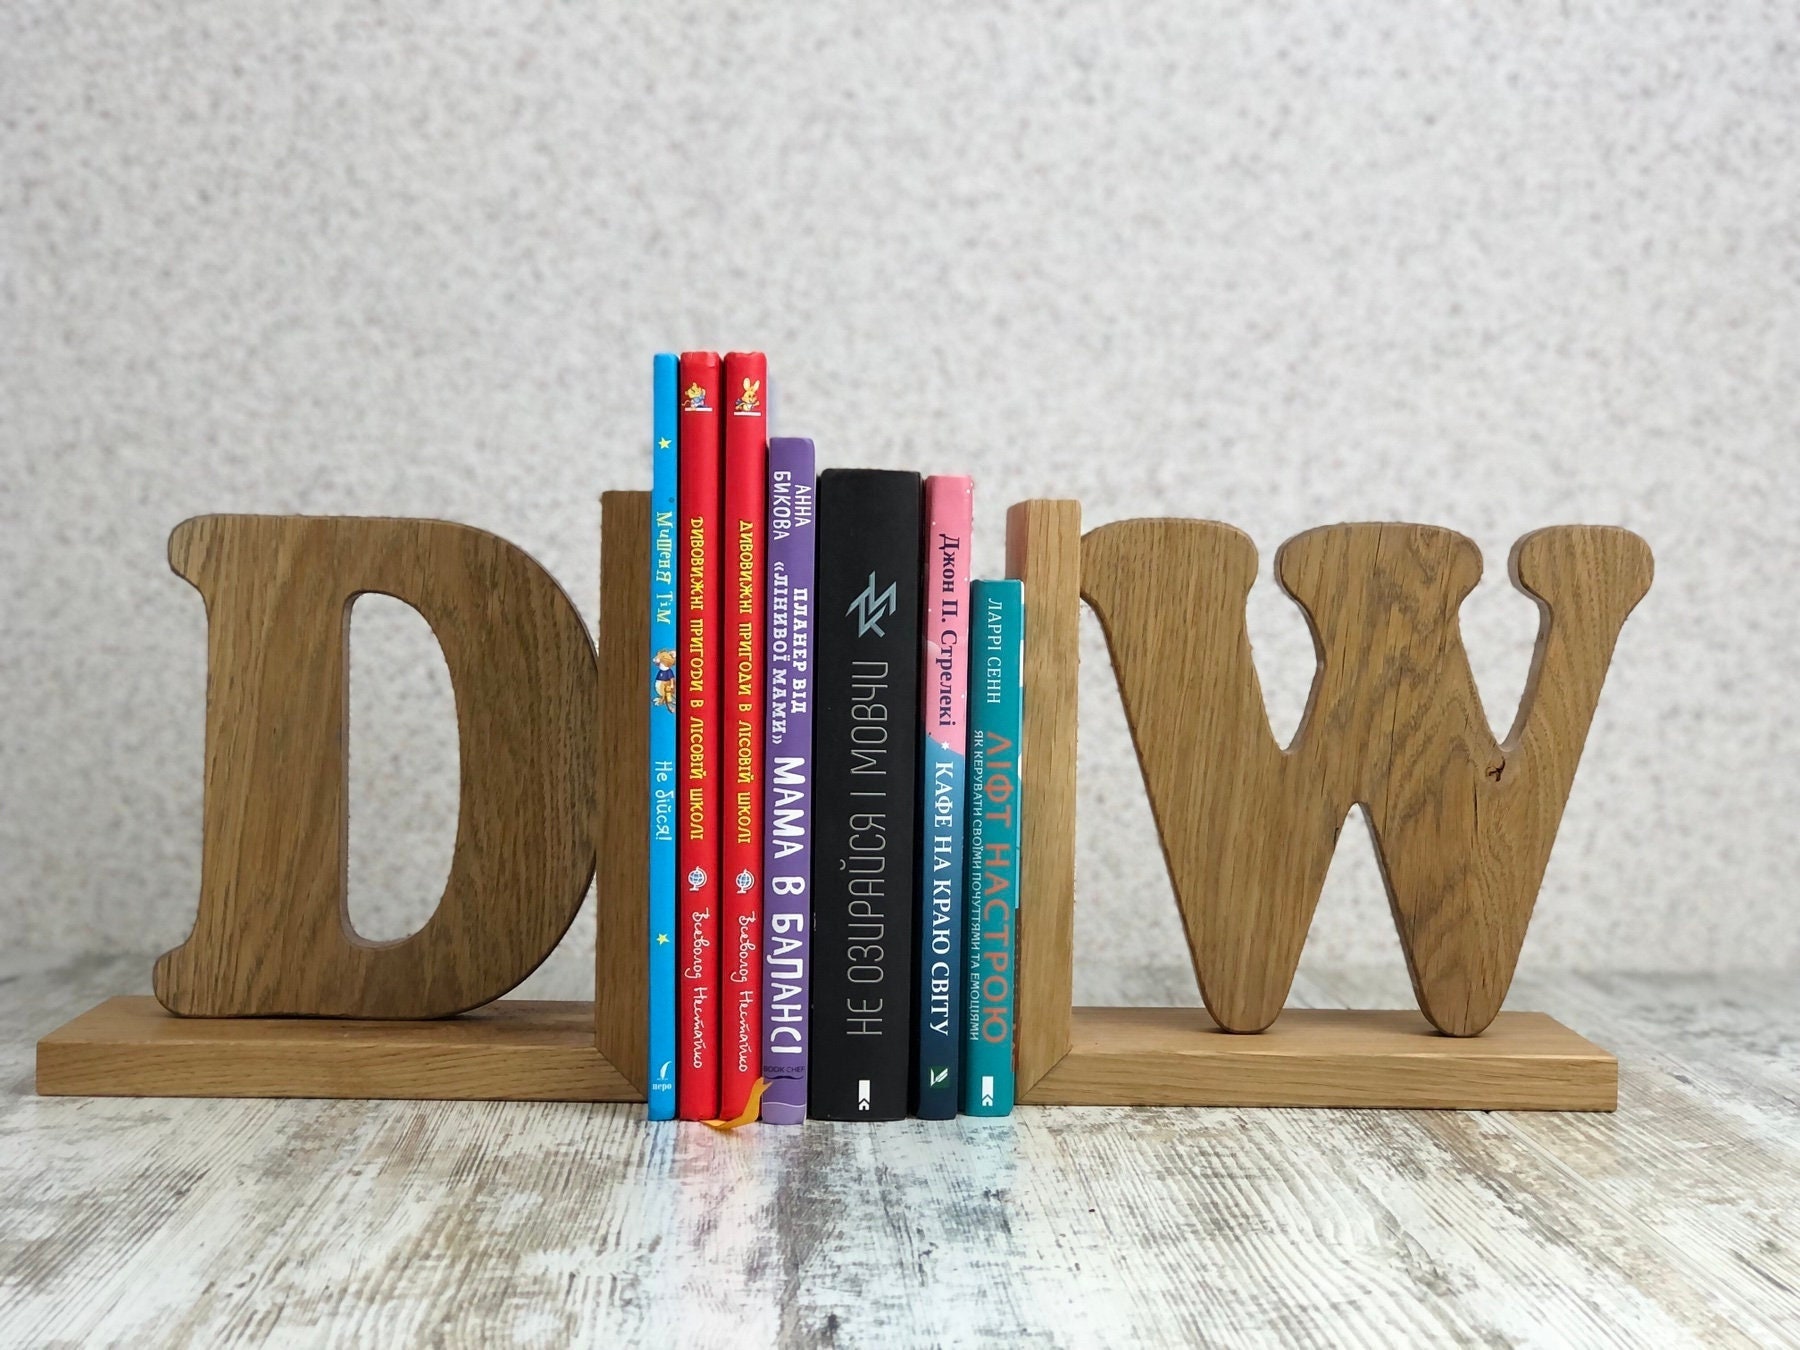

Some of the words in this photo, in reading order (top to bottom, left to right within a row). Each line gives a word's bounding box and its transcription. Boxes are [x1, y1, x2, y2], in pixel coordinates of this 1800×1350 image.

[773, 471, 791, 541] БИКОВА
[795, 484, 811, 527] АННА
[690, 517, 704, 610] ДИВОВИЖНІ
[738, 520, 752, 614] ДИВОВИЖНІ
[939, 533, 960, 595] Джон
[770, 561, 790, 664] «ЛІНИВОЇ
[792, 588, 807, 671] ПЛАНЕР
[938, 599, 959, 623] П.
[987, 598, 1002, 650] ЛАРРІ
[690, 619, 704, 692] ПРИГОДИ
[738, 622, 752, 696] ПРИГОДИ
[935, 629, 957, 727] Стрелекі
[986, 656, 1001, 704] СЕНН
[690, 700, 702, 708] В
[738, 704, 751, 712] В
[771, 668, 787, 745] МАМИ»
[790, 680, 806, 713] ВІД
[849, 660, 889, 775] МОВЧИ
[654, 761, 672, 783] Не
[688, 717, 706, 780] ЛІСОВІЙ
[736, 720, 754, 784] ЛІСОВІЙ
[973, 730, 984, 748] ЯК
[773, 757, 805, 860] МАМА
[934, 761, 954, 828] КАФЕ
[972, 751, 984, 816] КЕРУВАТИ
[984, 731, 1014, 828] ЛІФТ
[654, 790, 673, 841] бійся!
[690, 788, 704, 840] ШКОЛІ
[738, 792, 752, 844] ШКОЛІ
[972, 819, 984, 868] СВОЇМИ
[773, 876, 804, 895] В
[934, 836, 952, 872] НА
[840, 813, 886, 984] ОЗИРАЙСЯ
[933, 879, 952, 955] КРАЮ
[970, 873, 982, 949] ПОЧУТТЯМИ
[684, 908, 709, 979] Всеволод
[731, 911, 756, 983] Всеволод
[970, 953, 980, 968] ТА
[983, 843, 1011, 1043] НАСТРОЮ
[766, 913, 804, 1055] БАЛАНСІ
[846, 998, 883, 1036] НЕ
[930, 961, 950, 1035] СВІТУ
[969, 972, 980, 1041] ЕМОЦІЯМИ
[692, 987, 708, 1069] Нестайко
[738, 990, 753, 1073] Нестайко
[652, 1083, 672, 1092] перо
[763, 1065, 785, 1074] BOOK
[785, 1065, 805, 1074] CHEF
